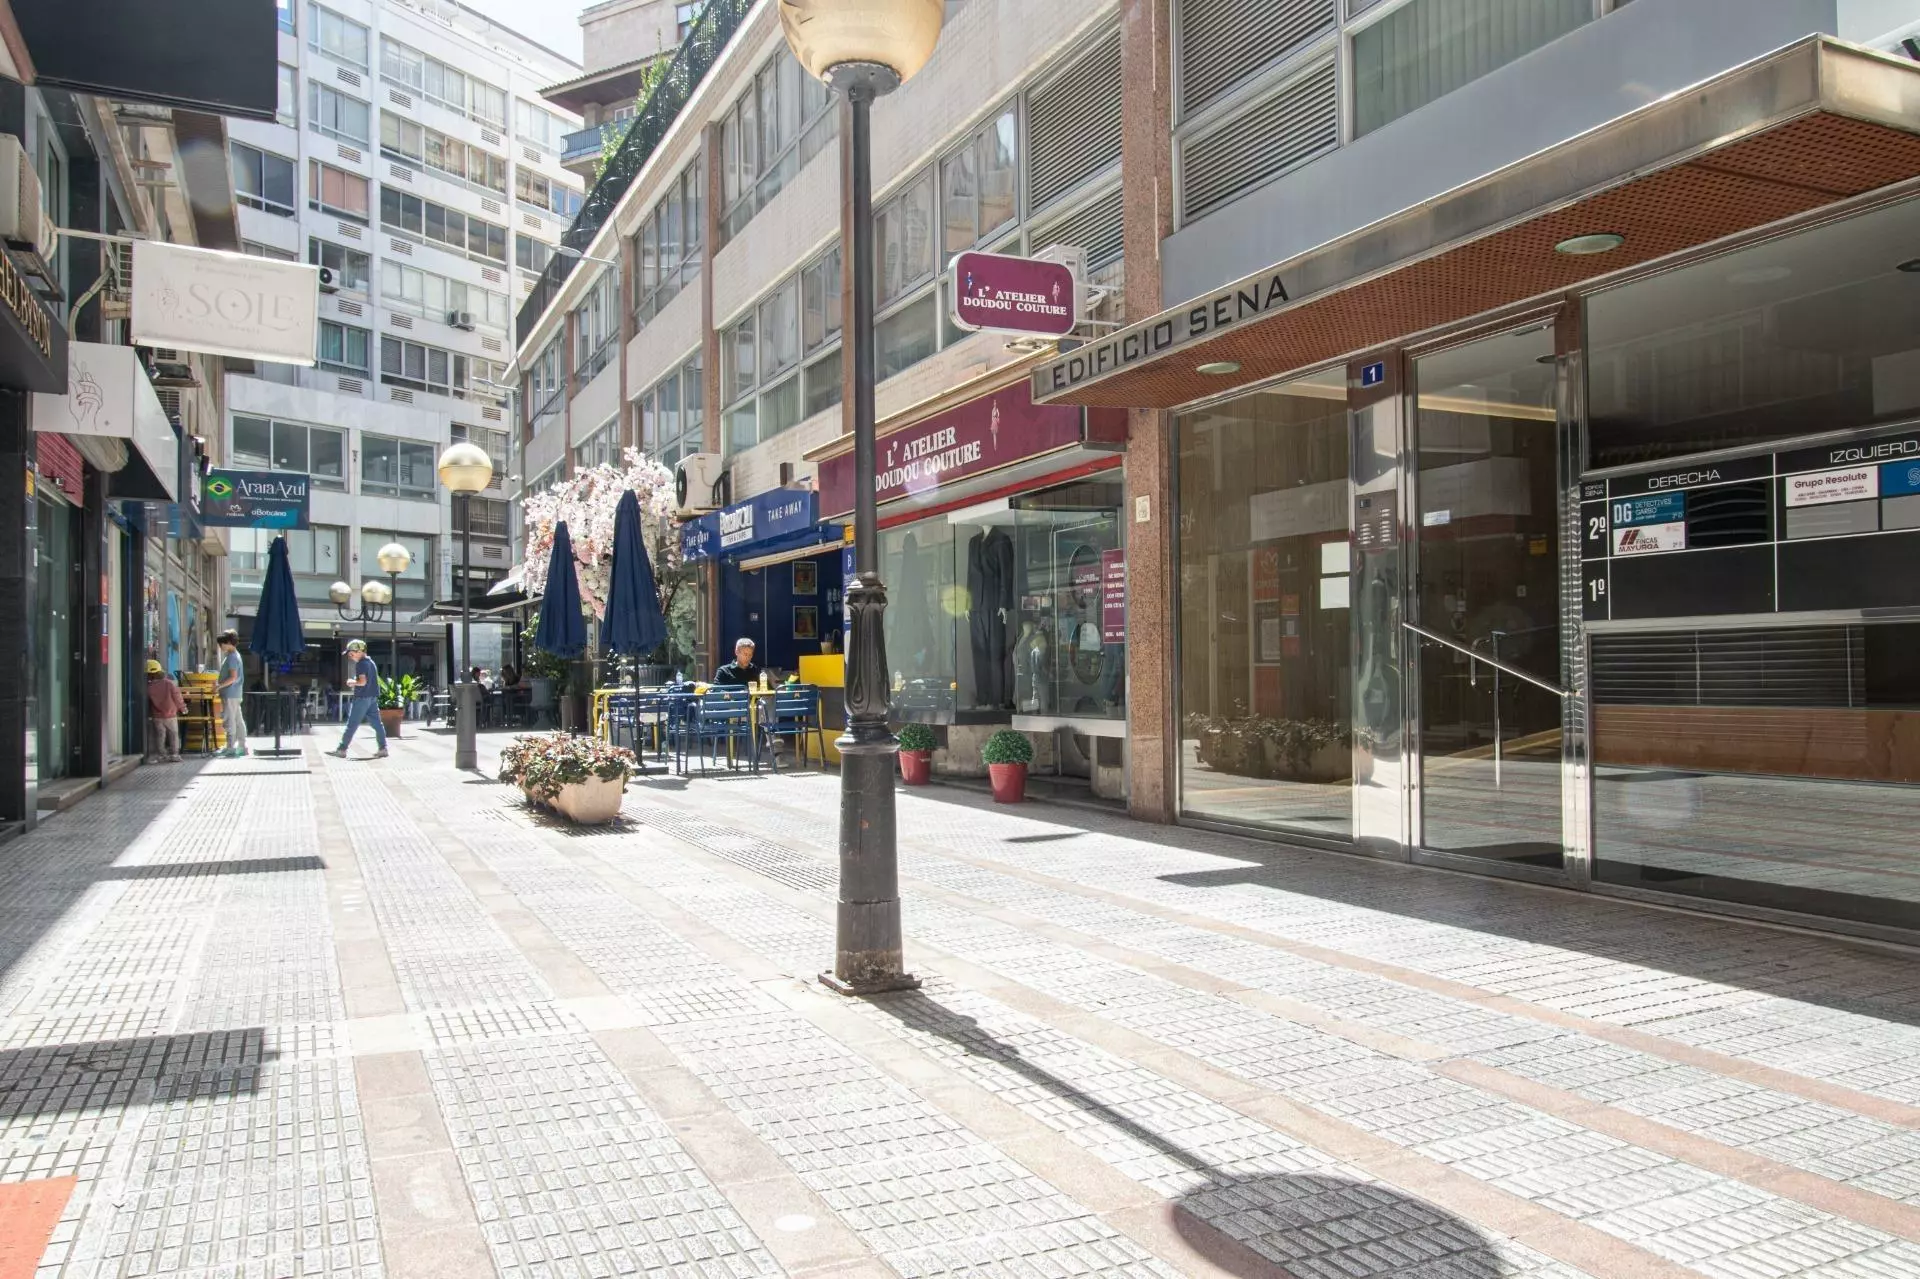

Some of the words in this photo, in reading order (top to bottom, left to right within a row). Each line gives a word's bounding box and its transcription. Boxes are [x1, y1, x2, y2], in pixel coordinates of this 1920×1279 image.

[978, 286, 990, 298] L'
[995, 290, 1047, 304] ATELIER
[186, 283, 295, 331] SOLE
[963, 297, 1012, 310] DOUDOU
[1016, 303, 1067, 315] COUTURE
[1053, 319, 1172, 390] EDIFICIO
[1189, 275, 1289, 337] SENA
[1368, 366, 1376, 382] 1
[887, 441, 898, 467] L'
[903, 426, 957, 462] ATELIER
[1830, 440, 1920, 463] IZQUIERD
[876, 461, 920, 492] DOUDOU
[924, 440, 982, 476] COUTURE
[1648, 469, 1721, 489] DERECHA
[1794, 478, 1823, 489] Grupo
[1825, 472, 1868, 484] Resolute
[768, 507, 783, 523] TAKE
[784, 501, 802, 516] AWAY
[1635, 498, 1672, 508] DETECTIVES
[1635, 507, 1657, 515] GARBO
[1613, 503, 1632, 524] DG
[686, 535, 697, 547] TAKE
[1589, 579, 1605, 602] 1º
